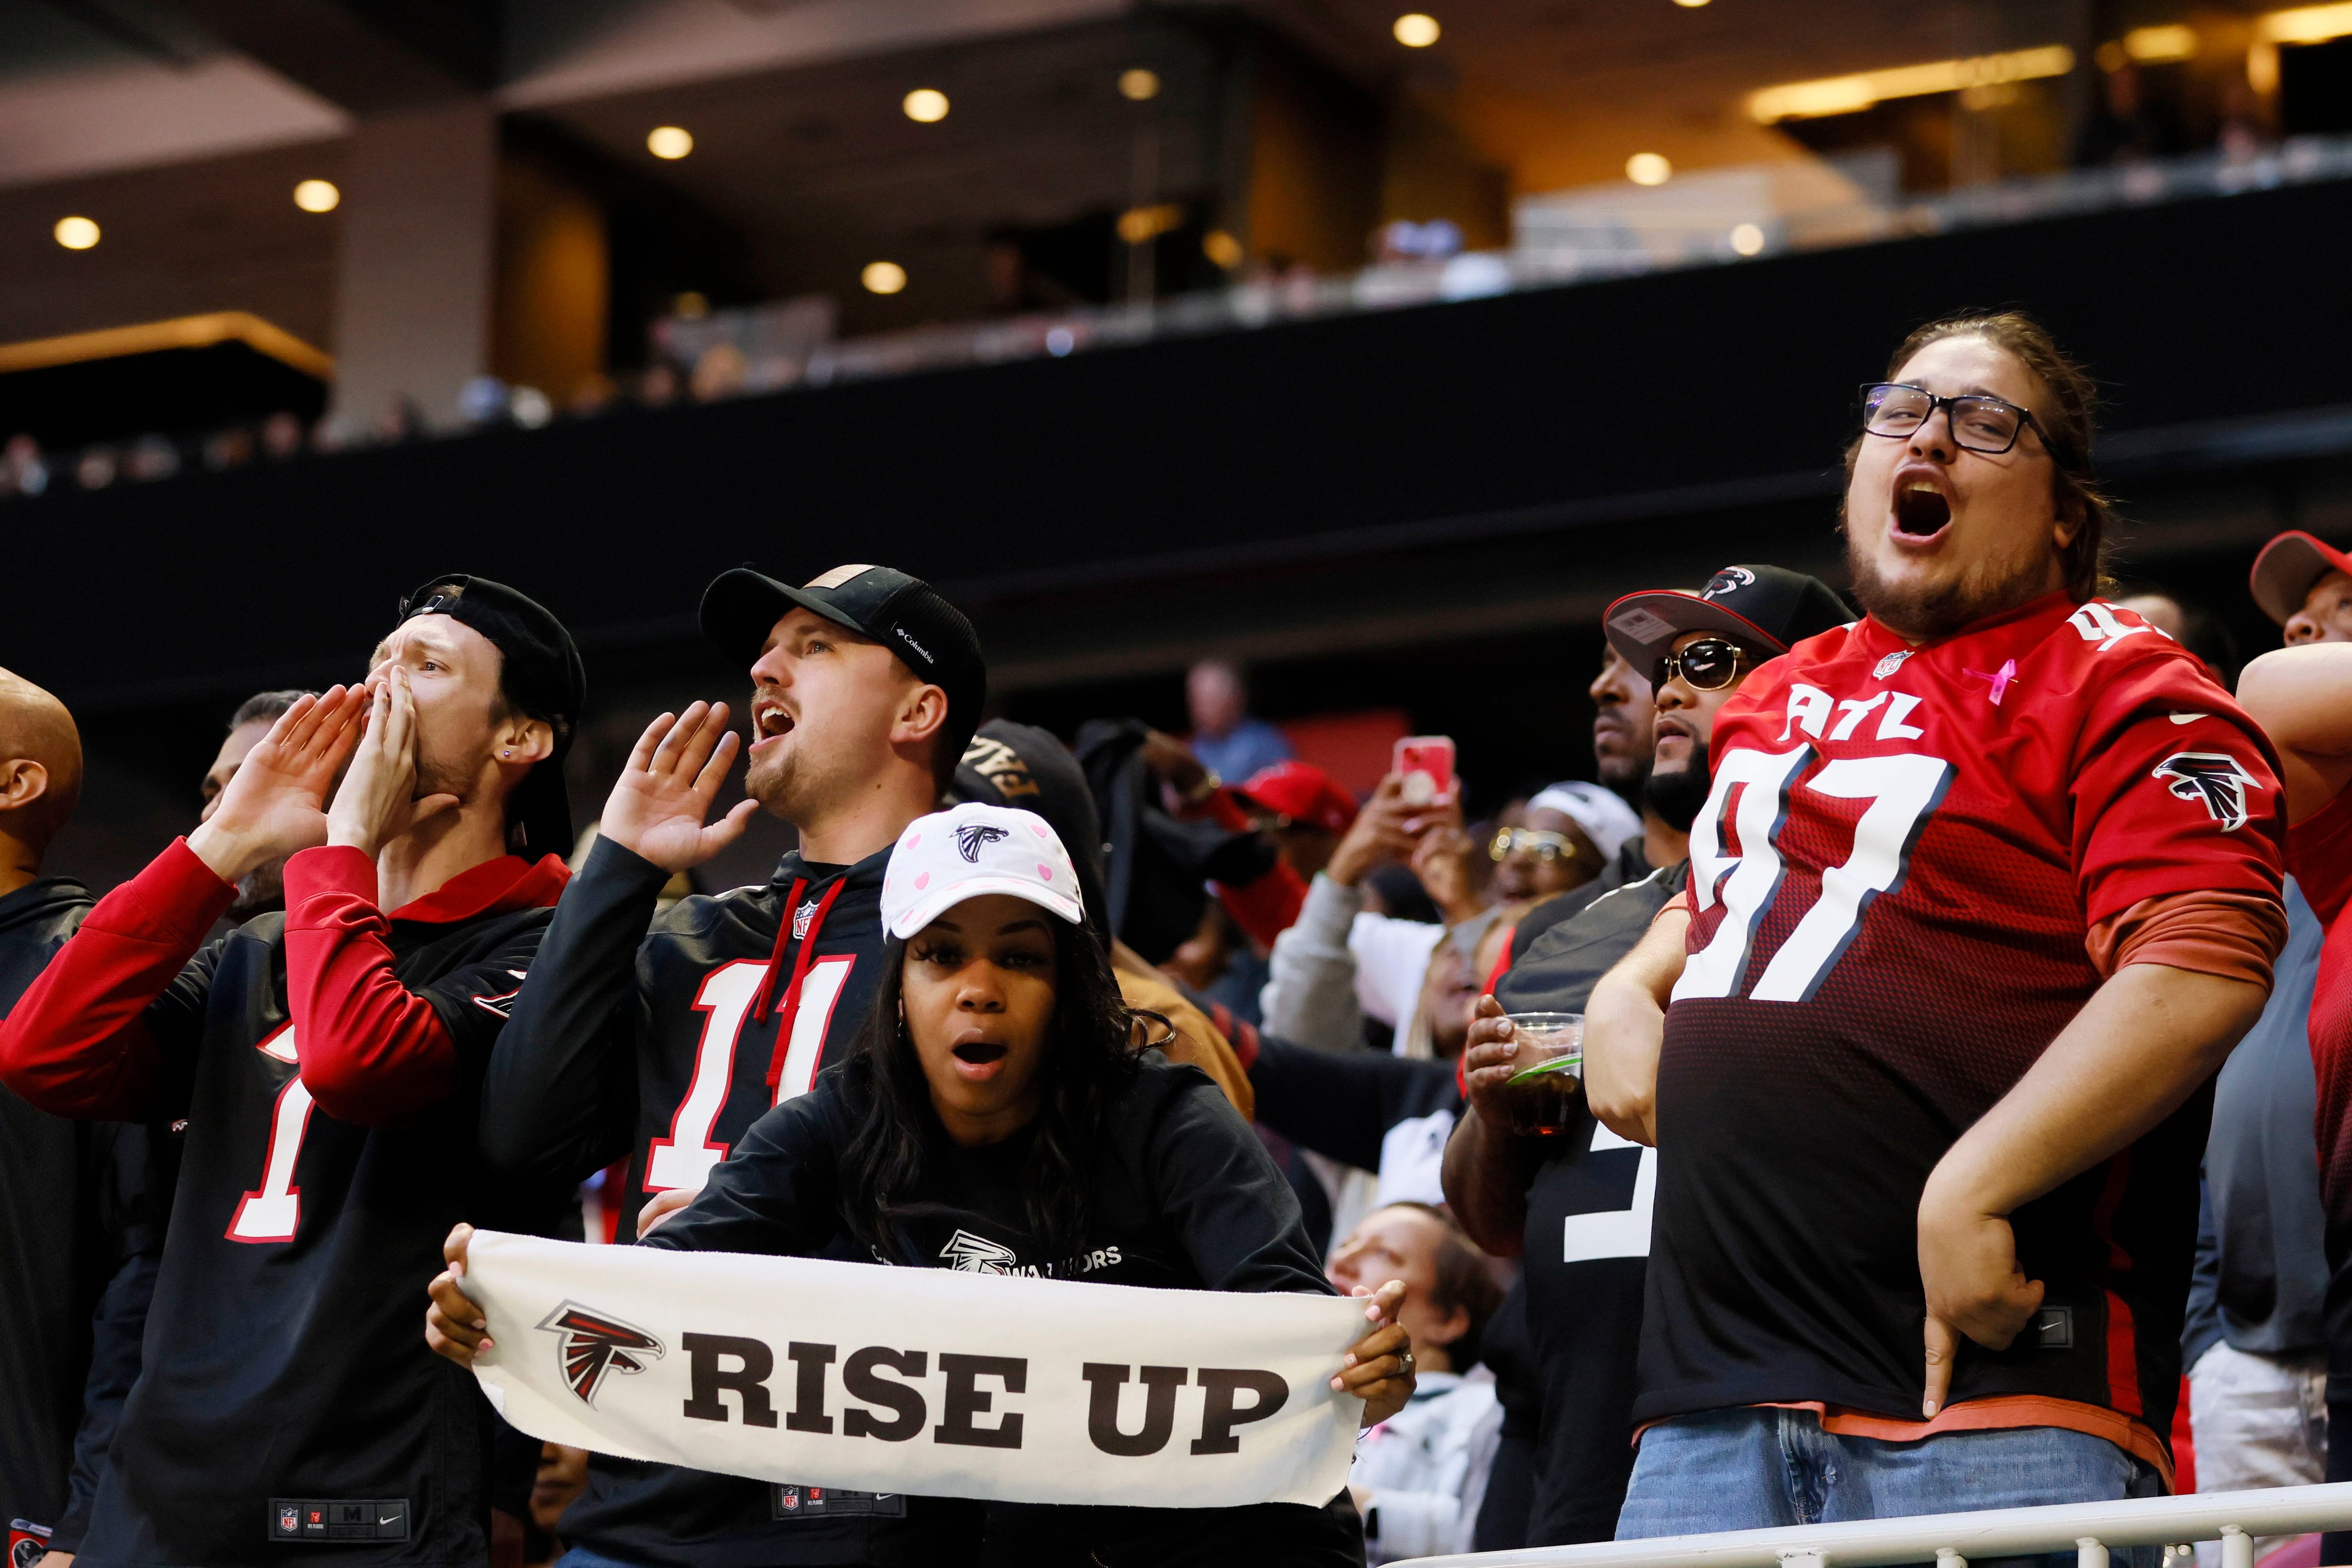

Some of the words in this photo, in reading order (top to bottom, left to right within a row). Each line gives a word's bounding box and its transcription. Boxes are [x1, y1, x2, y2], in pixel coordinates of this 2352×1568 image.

[904, 634, 934, 664] Columbia
[1777, 683, 1924, 741] ATL
[1670, 741, 1958, 1003] 97
[643, 954, 857, 1193] 11
[682, 1332, 1028, 1449] RISE
[1082, 1362, 1289, 1457] UP
[283, 1517, 295, 1527] NFL
[785, 1496, 797, 1507] NFL
